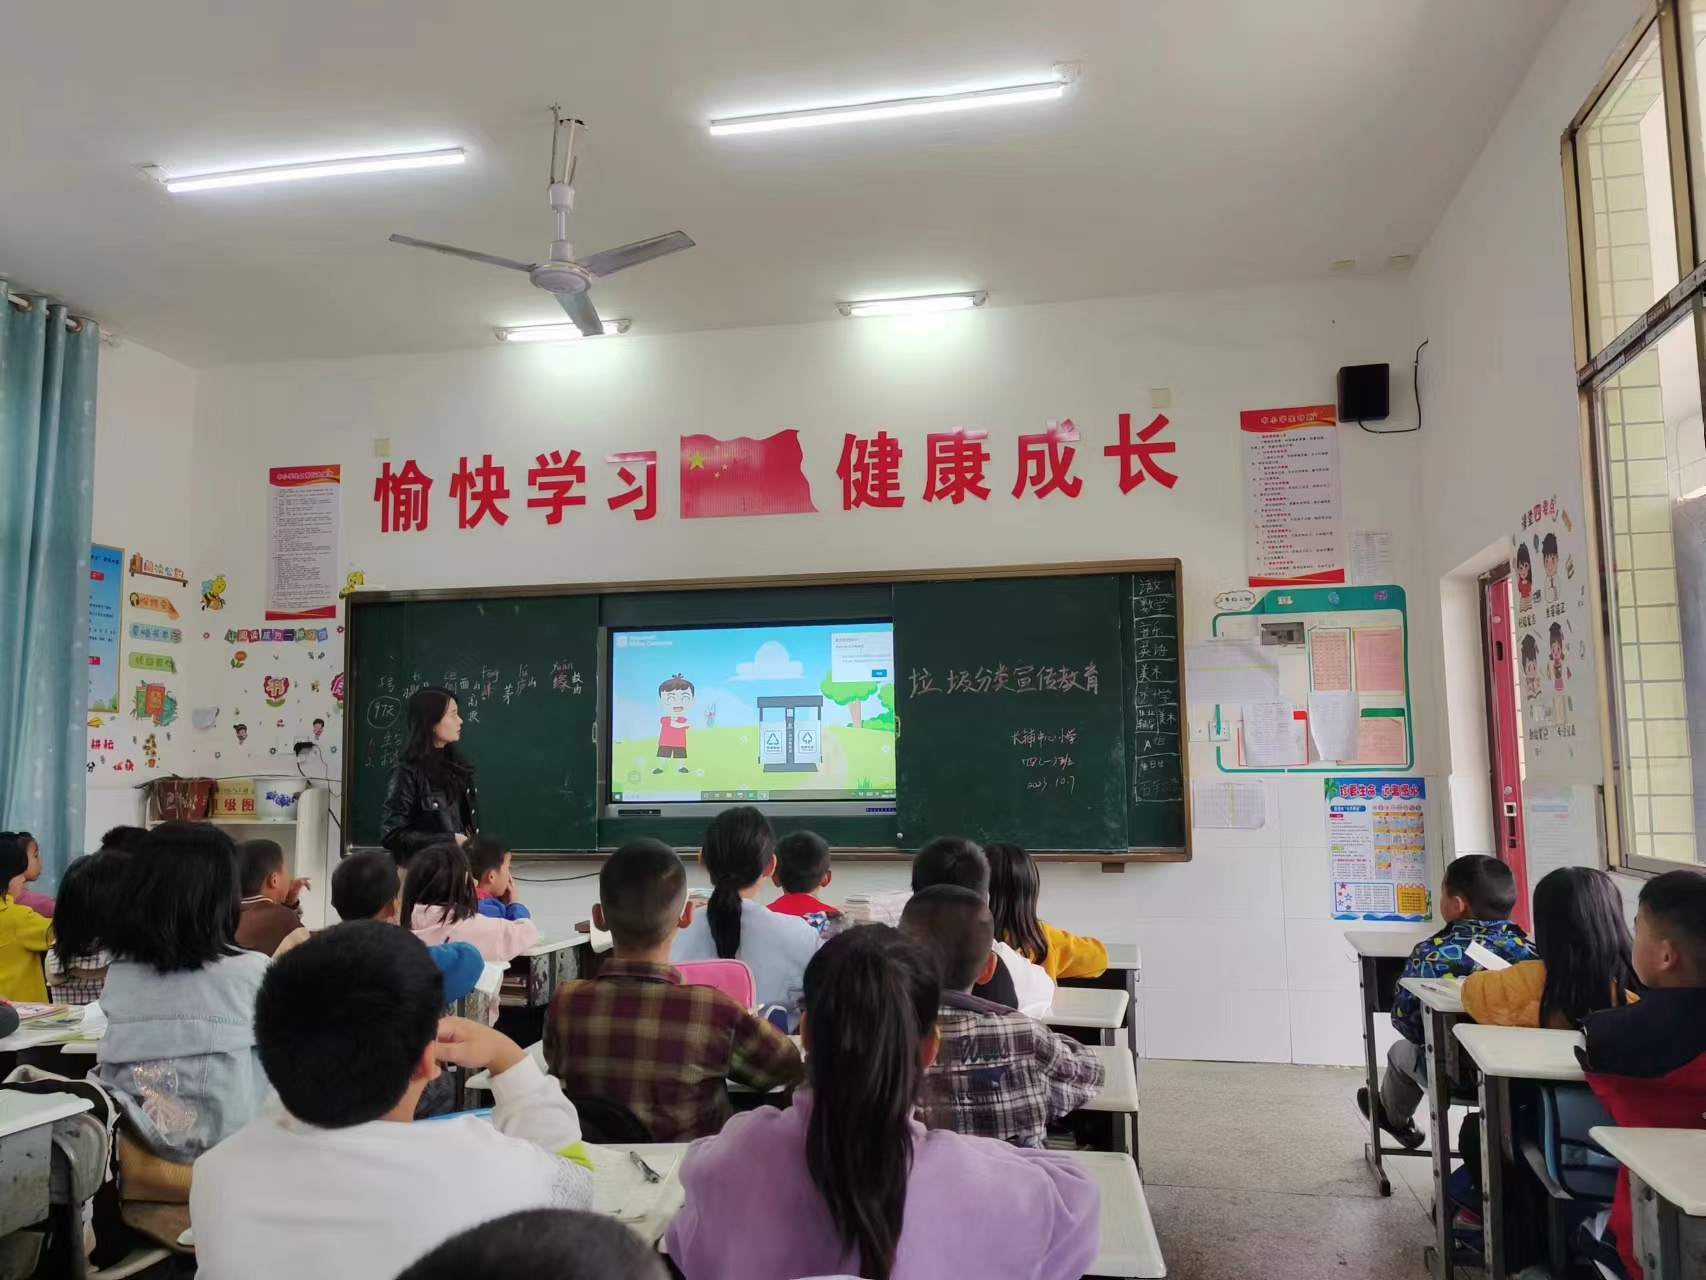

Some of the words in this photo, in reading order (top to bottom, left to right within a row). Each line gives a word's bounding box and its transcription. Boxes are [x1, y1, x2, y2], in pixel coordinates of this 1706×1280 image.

[374, 450, 657, 533] 愉快学习
[836, 413, 1179, 511] 健康成长
[143, 559, 184, 578] 阅读公约
[1139, 578, 1161, 595] 语文
[1139, 598, 1168, 614] 数学
[226, 628, 327, 642] 让阅读成为一种习惯
[909, 661, 1099, 698] 垃圾分类宣传教育
[1340, 784, 1376, 797] 珍爱生命
